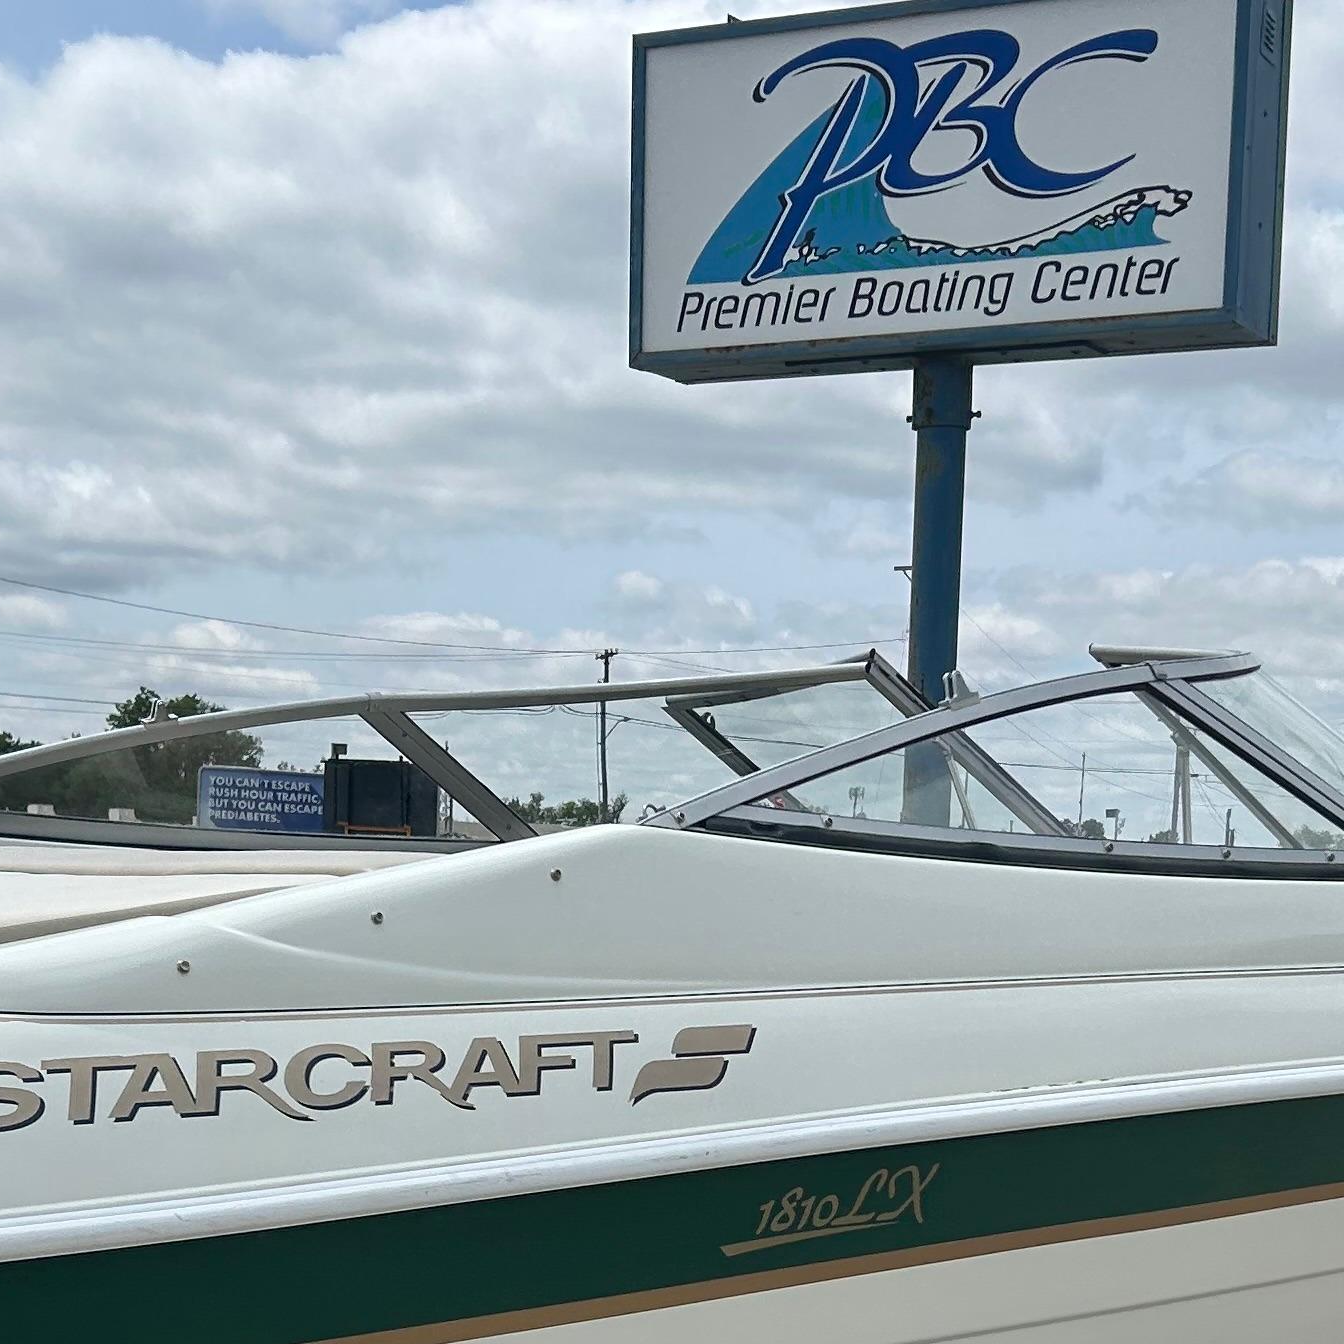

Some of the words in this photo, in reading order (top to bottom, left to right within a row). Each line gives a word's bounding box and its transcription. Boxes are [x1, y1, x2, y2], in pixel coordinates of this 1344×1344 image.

[753, 28, 1159, 285] PBC
[676, 283, 837, 333] Premier
[848, 269, 1015, 319] Boating
[1031, 255, 1179, 302] Center
[208, 776, 233, 786] YOU
[236, 778, 269, 788] CAN'T
[271, 780, 310, 792] ESCAPE
[208, 787, 238, 798] RUSH
[241, 790, 274, 801] HOUR
[276, 792, 322, 805] TRAFFIC,
[208, 798, 230, 808] BUT
[231, 799, 256, 810] YOU
[258, 802, 282, 812] CAN
[284, 803, 324, 815] ESCAPE
[755, 1186, 840, 1236] 1810
